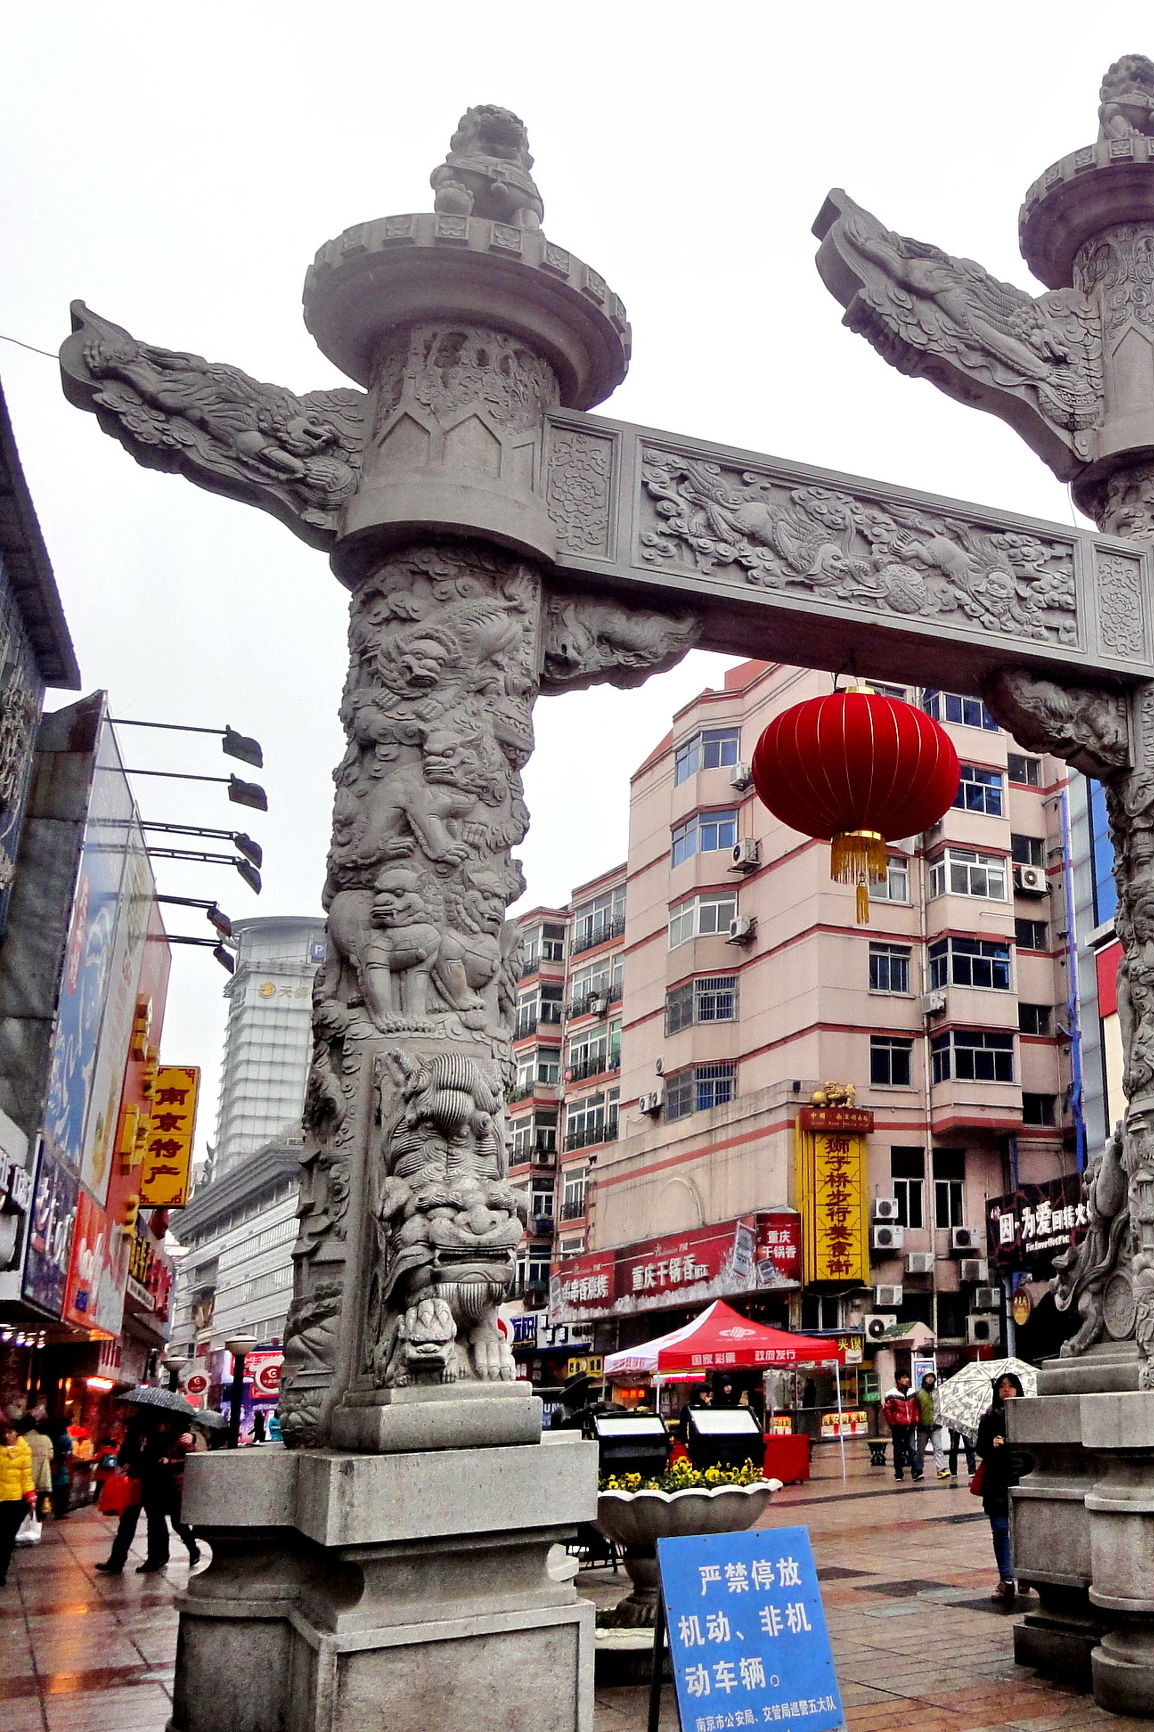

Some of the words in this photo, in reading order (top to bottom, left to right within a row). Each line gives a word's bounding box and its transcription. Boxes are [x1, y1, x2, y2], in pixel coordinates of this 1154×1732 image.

[144, 1086, 190, 1185] 南京特产
[766, 1229, 791, 1245] 重庆
[761, 1245, 797, 1259] 干锅香
[632, 1253, 696, 1292] 重庆干锅香
[691, 1352, 737, 1366] 国家彩票
[755, 1349, 797, 1362] 政府发行
[698, 1556, 802, 1596] 严禁停放
